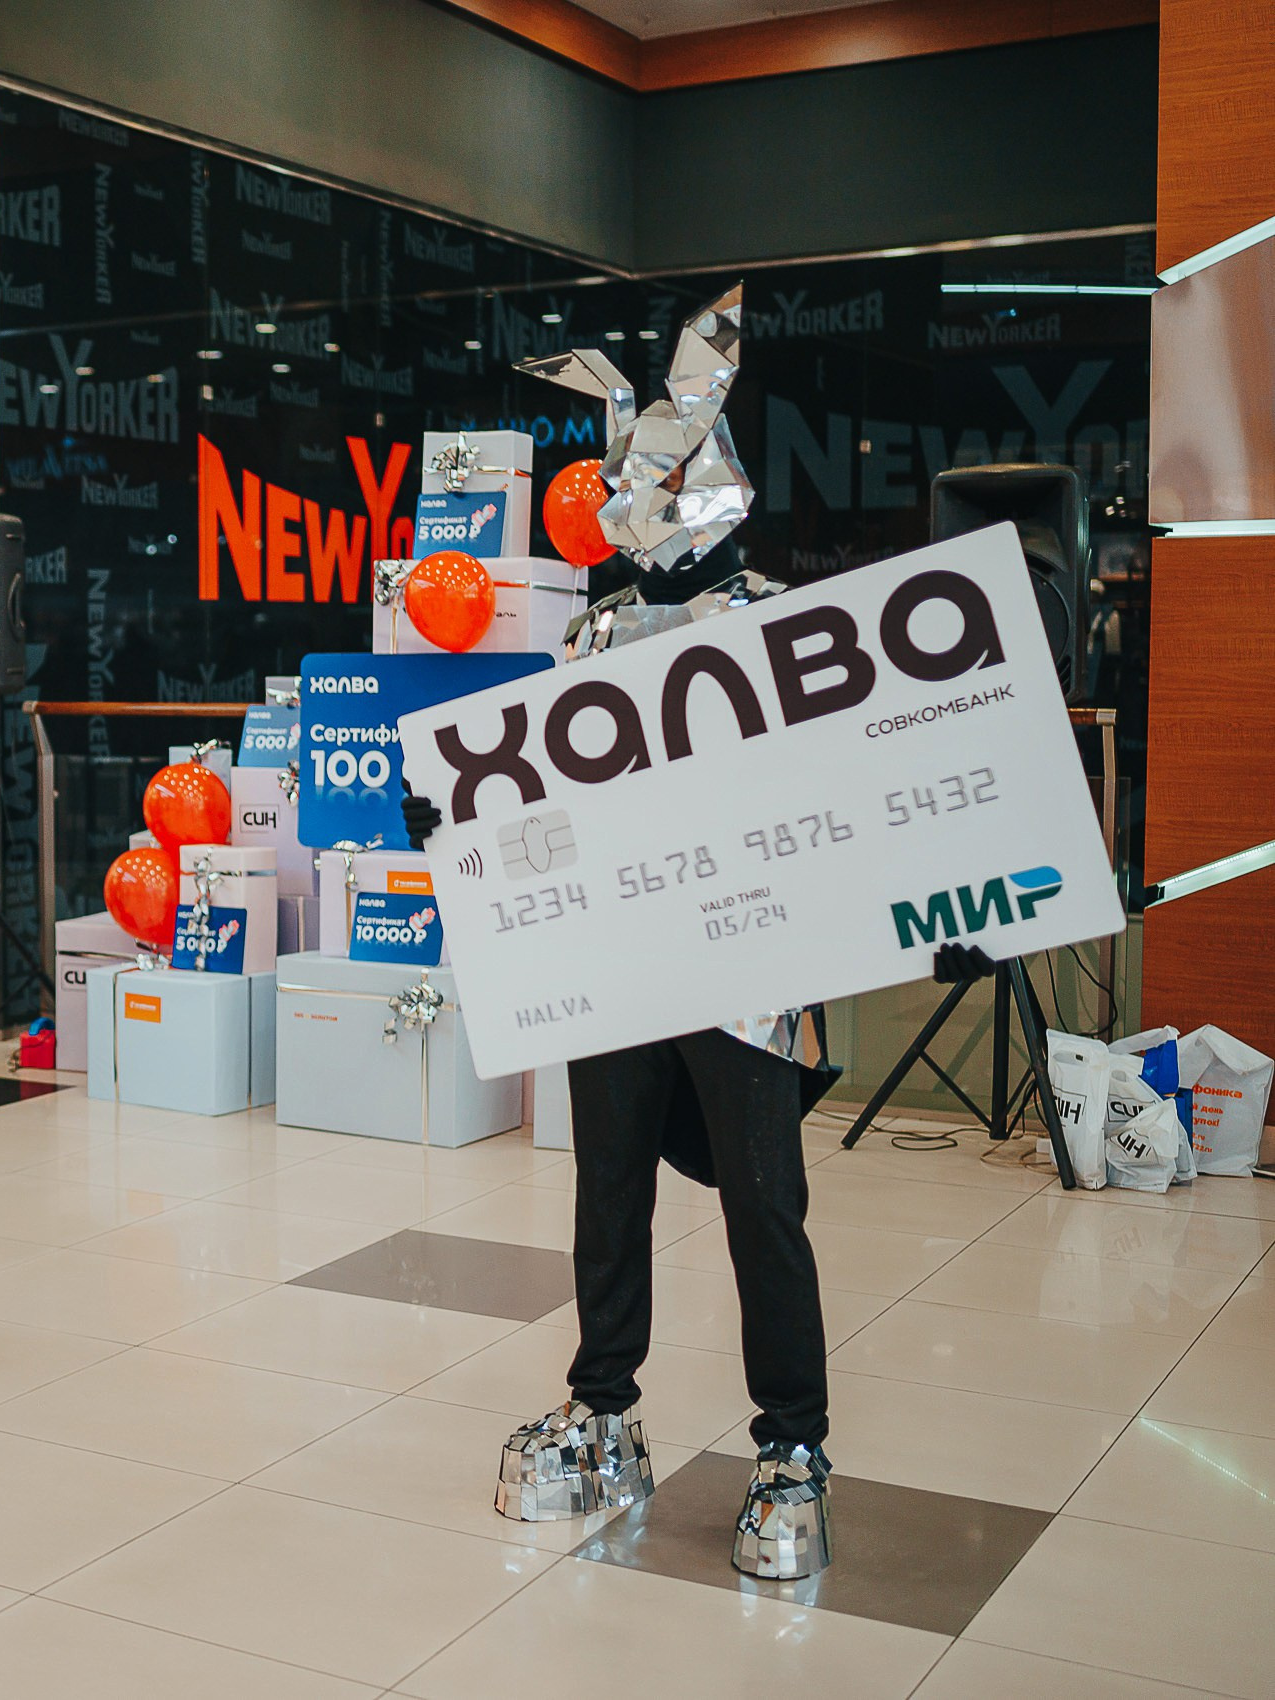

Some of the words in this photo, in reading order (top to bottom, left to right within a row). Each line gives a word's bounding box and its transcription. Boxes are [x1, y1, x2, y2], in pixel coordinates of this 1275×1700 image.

[865, 683, 1015, 738] СОВКОМБАНК
[310, 749, 391, 788] 100
[490, 883, 588, 933] 1234
[617, 845, 718, 899] 5678
[743, 810, 854, 861] 9876
[885, 767, 999, 826] 5432
[699, 896, 736, 913] VALID
[737, 886, 771, 904] THRU
[890, 865, 1063, 950] МИР
[704, 904, 787, 941] 05/24
[516, 996, 594, 1029] HALVA
